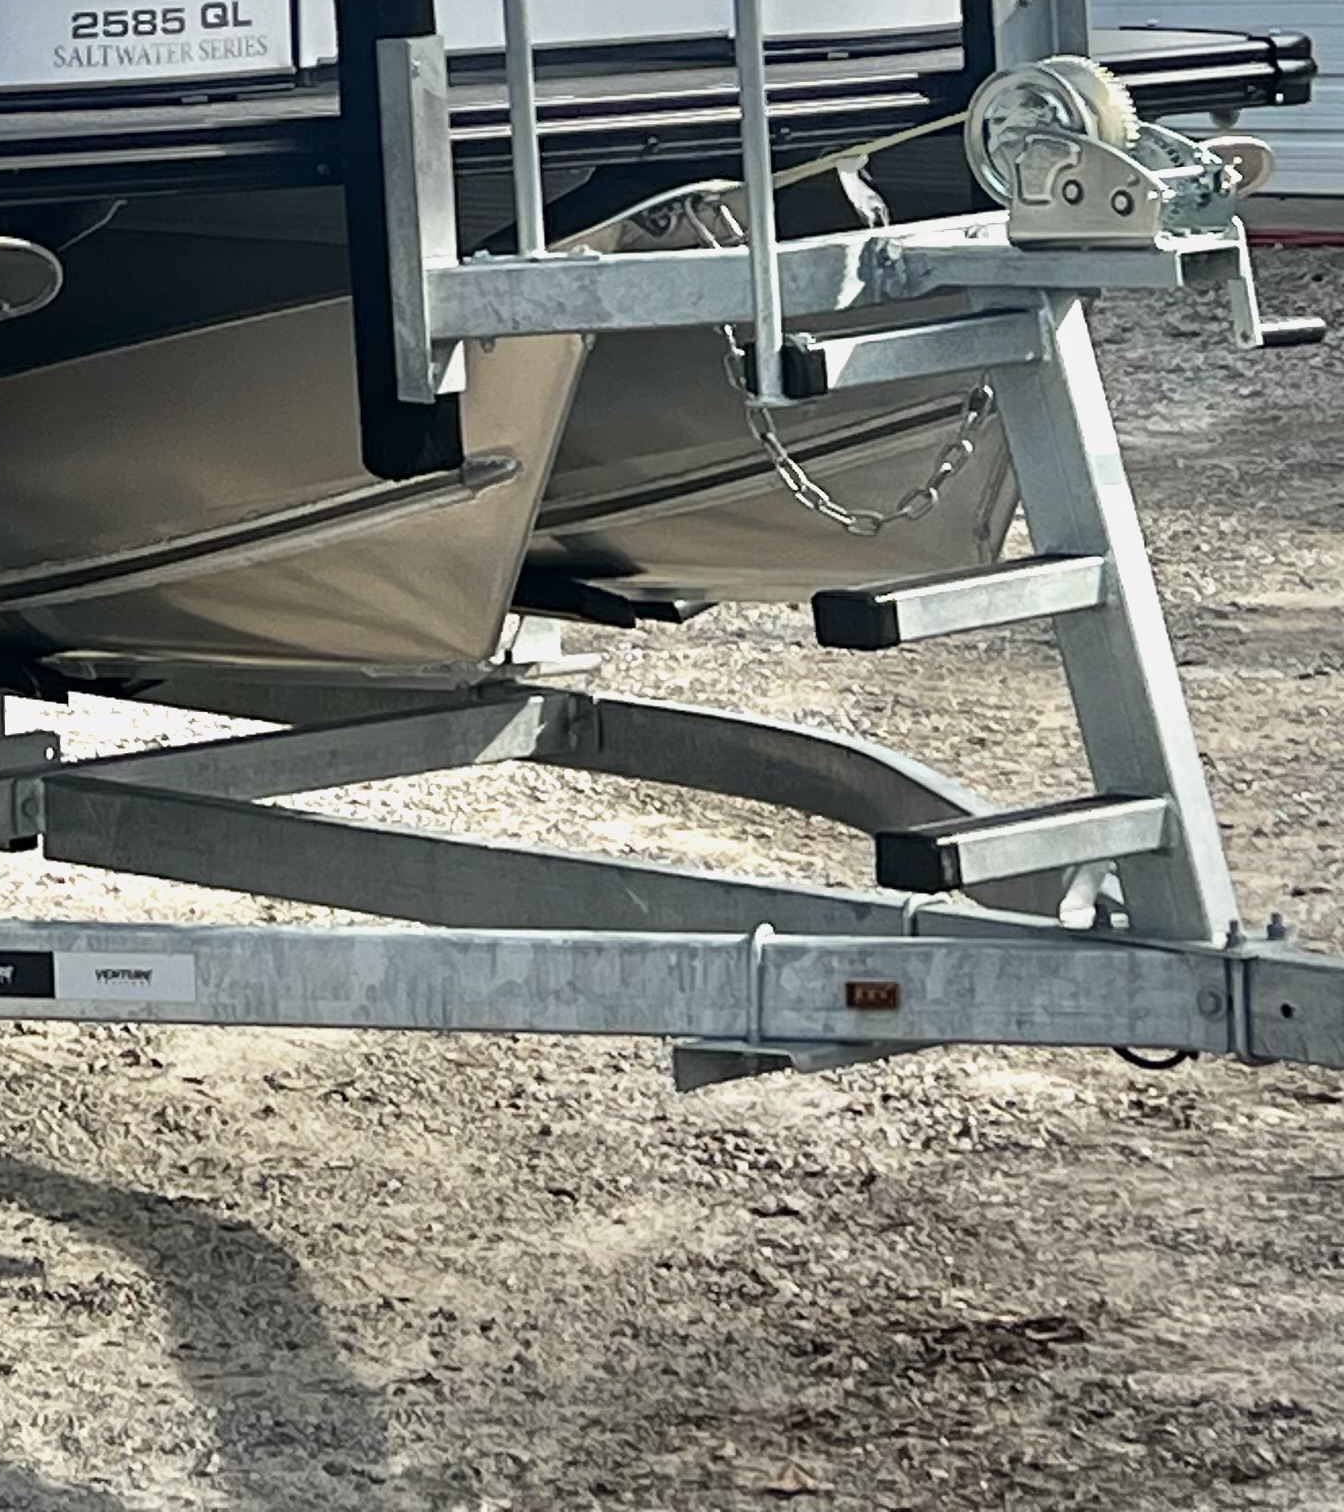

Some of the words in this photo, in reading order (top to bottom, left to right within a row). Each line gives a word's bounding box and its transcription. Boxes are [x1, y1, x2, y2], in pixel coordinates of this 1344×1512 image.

[72, 7, 186, 39] 2585
[201, 1, 253, 29] QL
[53, 43, 194, 69] SALTWATER
[199, 34, 268, 62] SERIES
[94, 968, 153, 982] VENTURE
